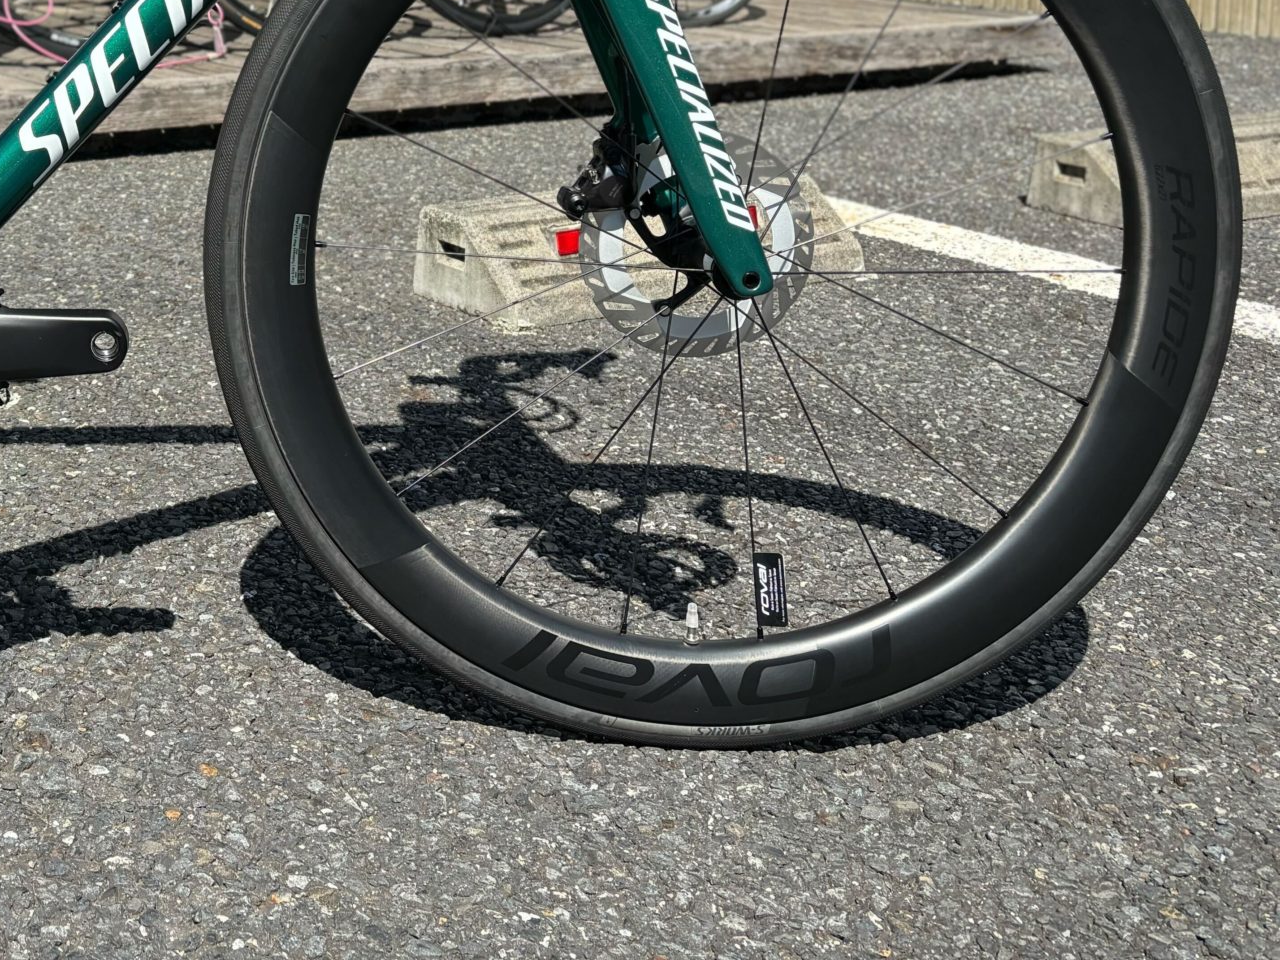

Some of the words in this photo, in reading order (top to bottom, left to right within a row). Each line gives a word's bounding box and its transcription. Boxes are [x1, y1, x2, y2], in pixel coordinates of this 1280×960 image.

[1151, 165, 1197, 388] RAPIDE
[756, 562, 771, 616] roval
[501, 623, 892, 707] roval
[696, 724, 765, 736] S-WORKS
